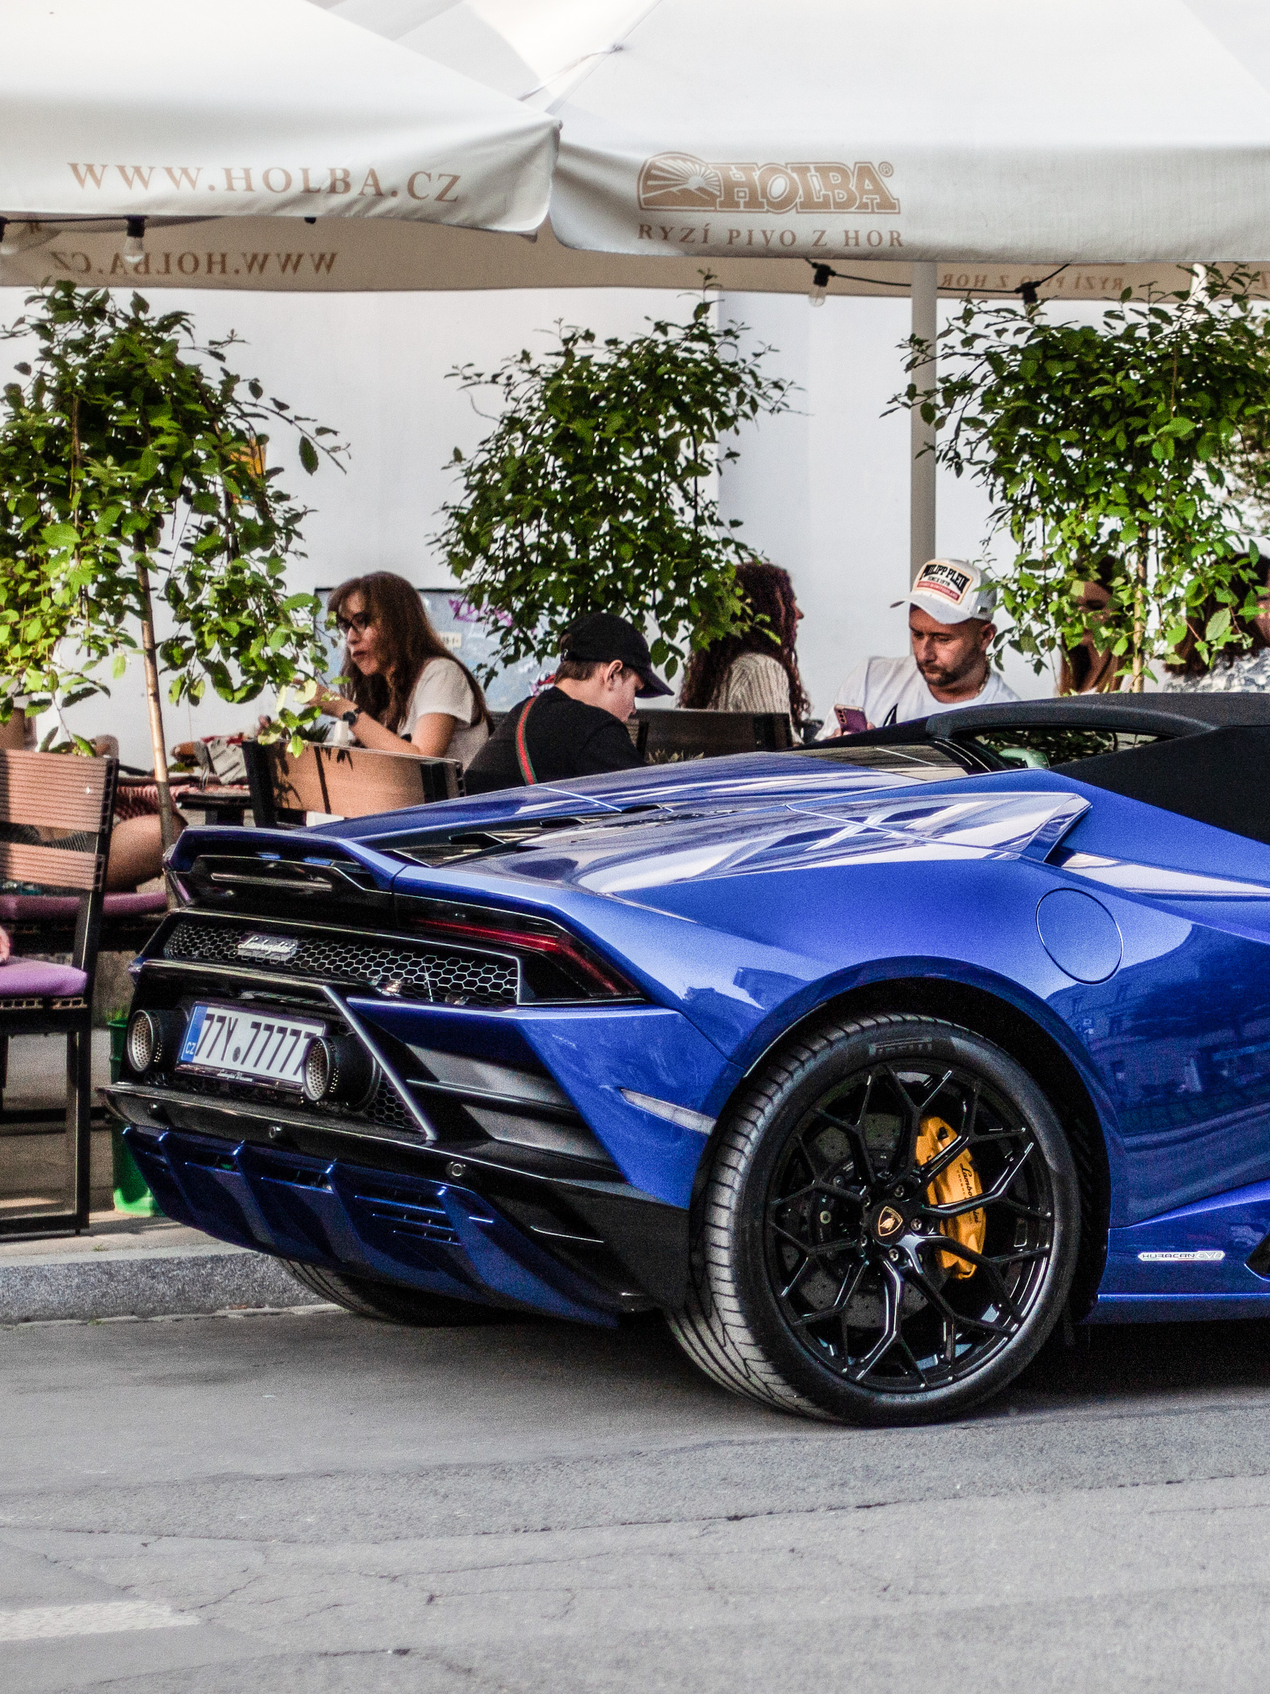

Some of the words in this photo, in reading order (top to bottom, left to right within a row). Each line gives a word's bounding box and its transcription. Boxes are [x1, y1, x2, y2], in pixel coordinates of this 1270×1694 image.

[69, 162, 461, 203] WWW.HOLBA.CZ
[637, 222, 710, 245] RYZÍ
[727, 228, 797, 248] PIVO
[812, 229, 828, 248] Z
[844, 229, 904, 249] HOR
[185, 1041, 196, 1055] CZ
